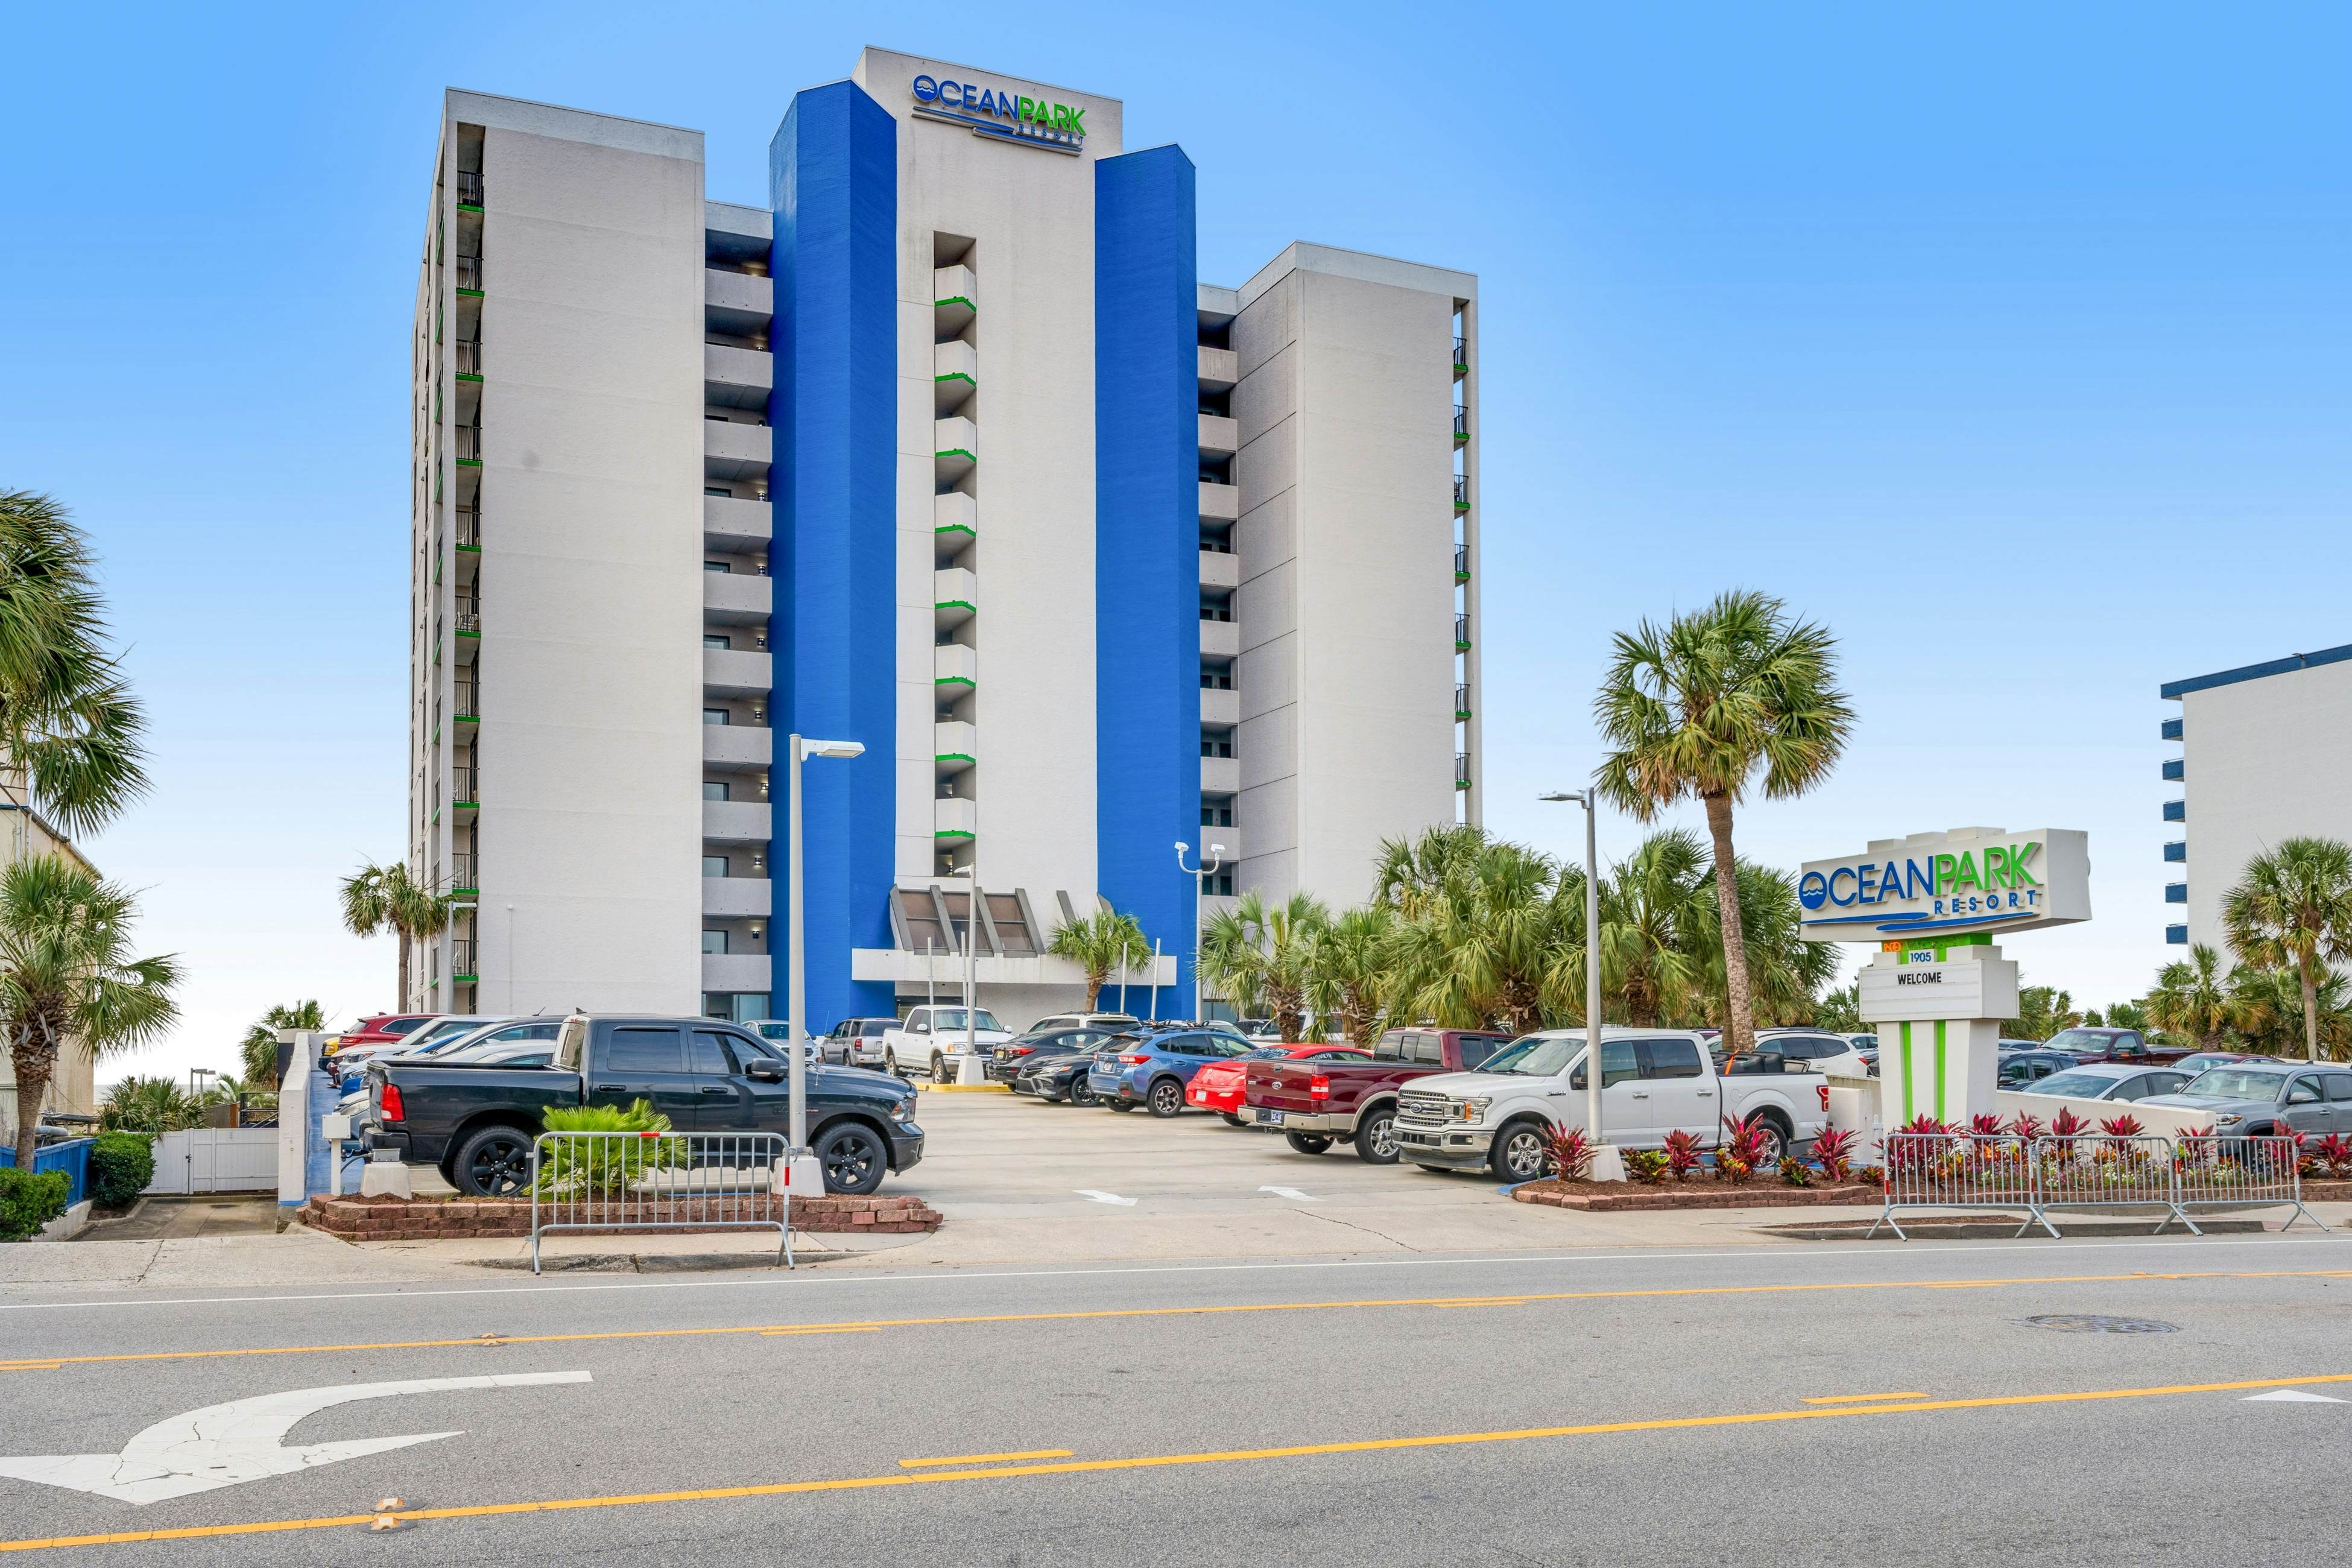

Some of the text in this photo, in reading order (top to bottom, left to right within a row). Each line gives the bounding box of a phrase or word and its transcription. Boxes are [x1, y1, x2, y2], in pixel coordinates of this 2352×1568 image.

[1019, 123, 1084, 145] RESORT
[1934, 890, 2036, 915] RESORT
[1909, 952, 1932, 963] 1905
[1897, 972, 1941, 985] WELCOME
